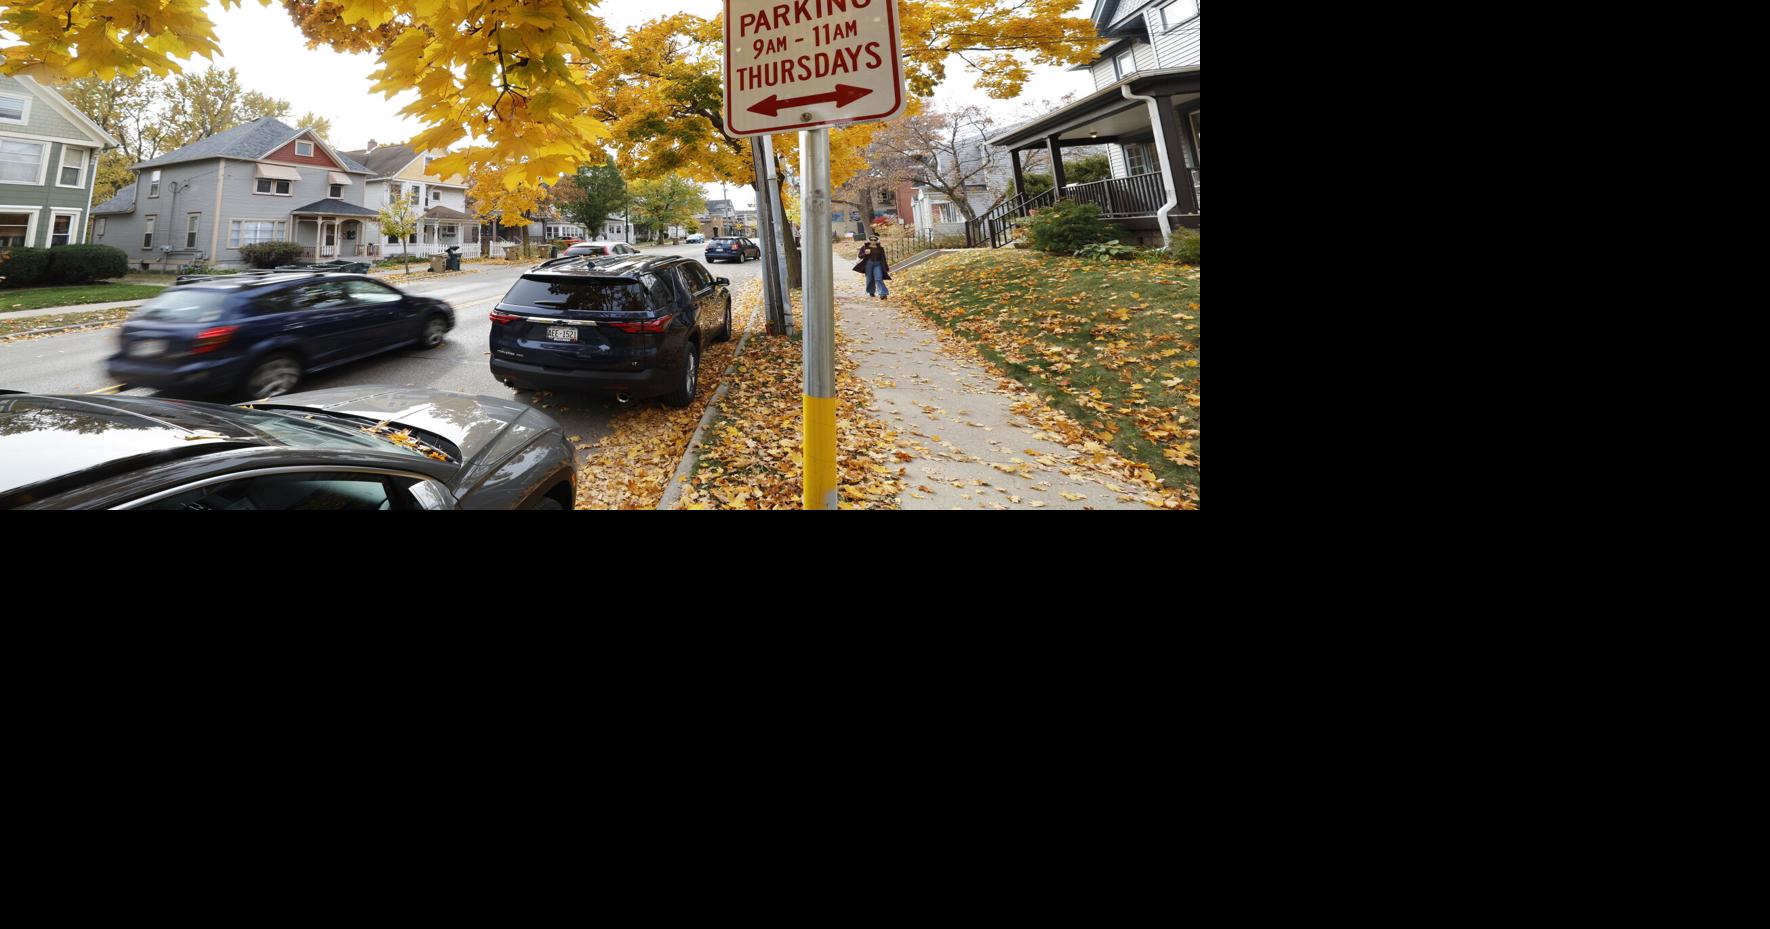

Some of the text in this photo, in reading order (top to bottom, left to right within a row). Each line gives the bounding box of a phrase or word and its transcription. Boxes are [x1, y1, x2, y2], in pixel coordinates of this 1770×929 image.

[753, 36, 787, 60] 9AM
[812, 20, 858, 47] 11AM
[736, 42, 882, 91] THURSDAYS
